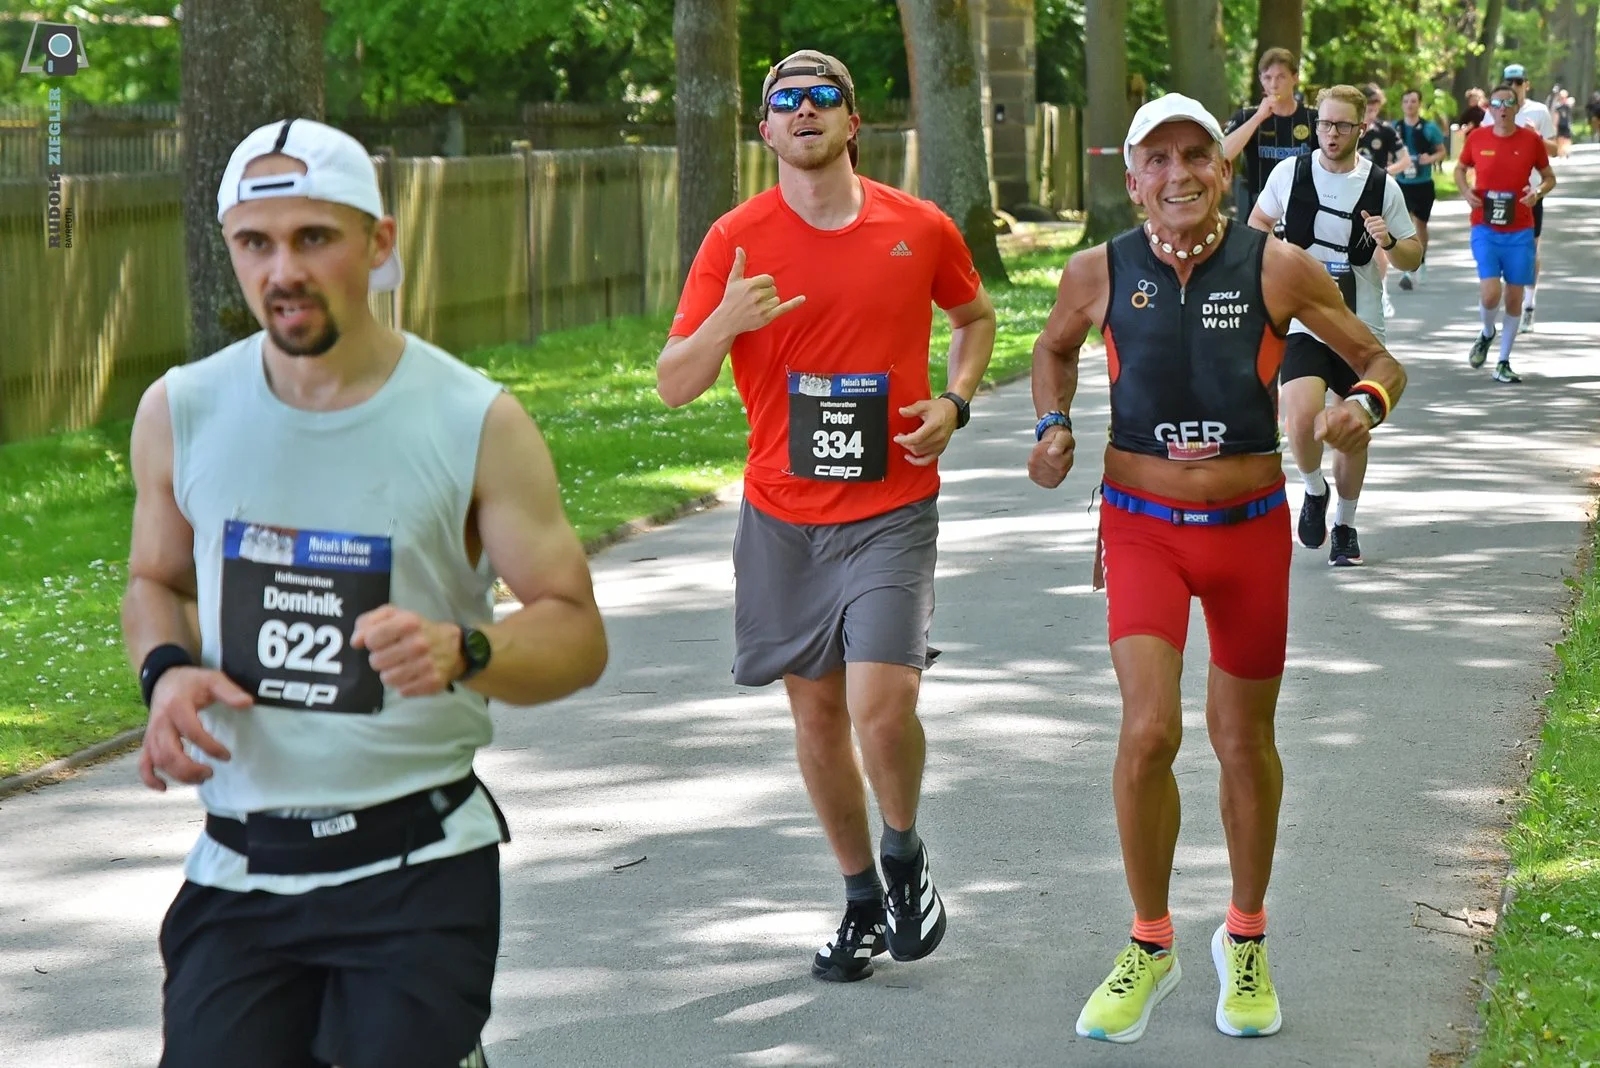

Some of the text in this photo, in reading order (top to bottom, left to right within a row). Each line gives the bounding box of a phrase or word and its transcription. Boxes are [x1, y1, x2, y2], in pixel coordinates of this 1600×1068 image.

[1492, 208, 1506, 219] 27
[1208, 291, 1240, 301] 2XU
[1202, 304, 1249, 315] Dieter
[1202, 317, 1241, 329] Wolf
[822, 411, 854, 424] Peter
[812, 430, 864, 459] 334
[814, 464, 862, 479] cep
[1183, 513, 1208, 522] SPORT
[275, 571, 334, 588] Halbmarathon
[263, 586, 343, 617] Dominik
[257, 619, 343, 675] 622
[257, 678, 339, 707] cep
